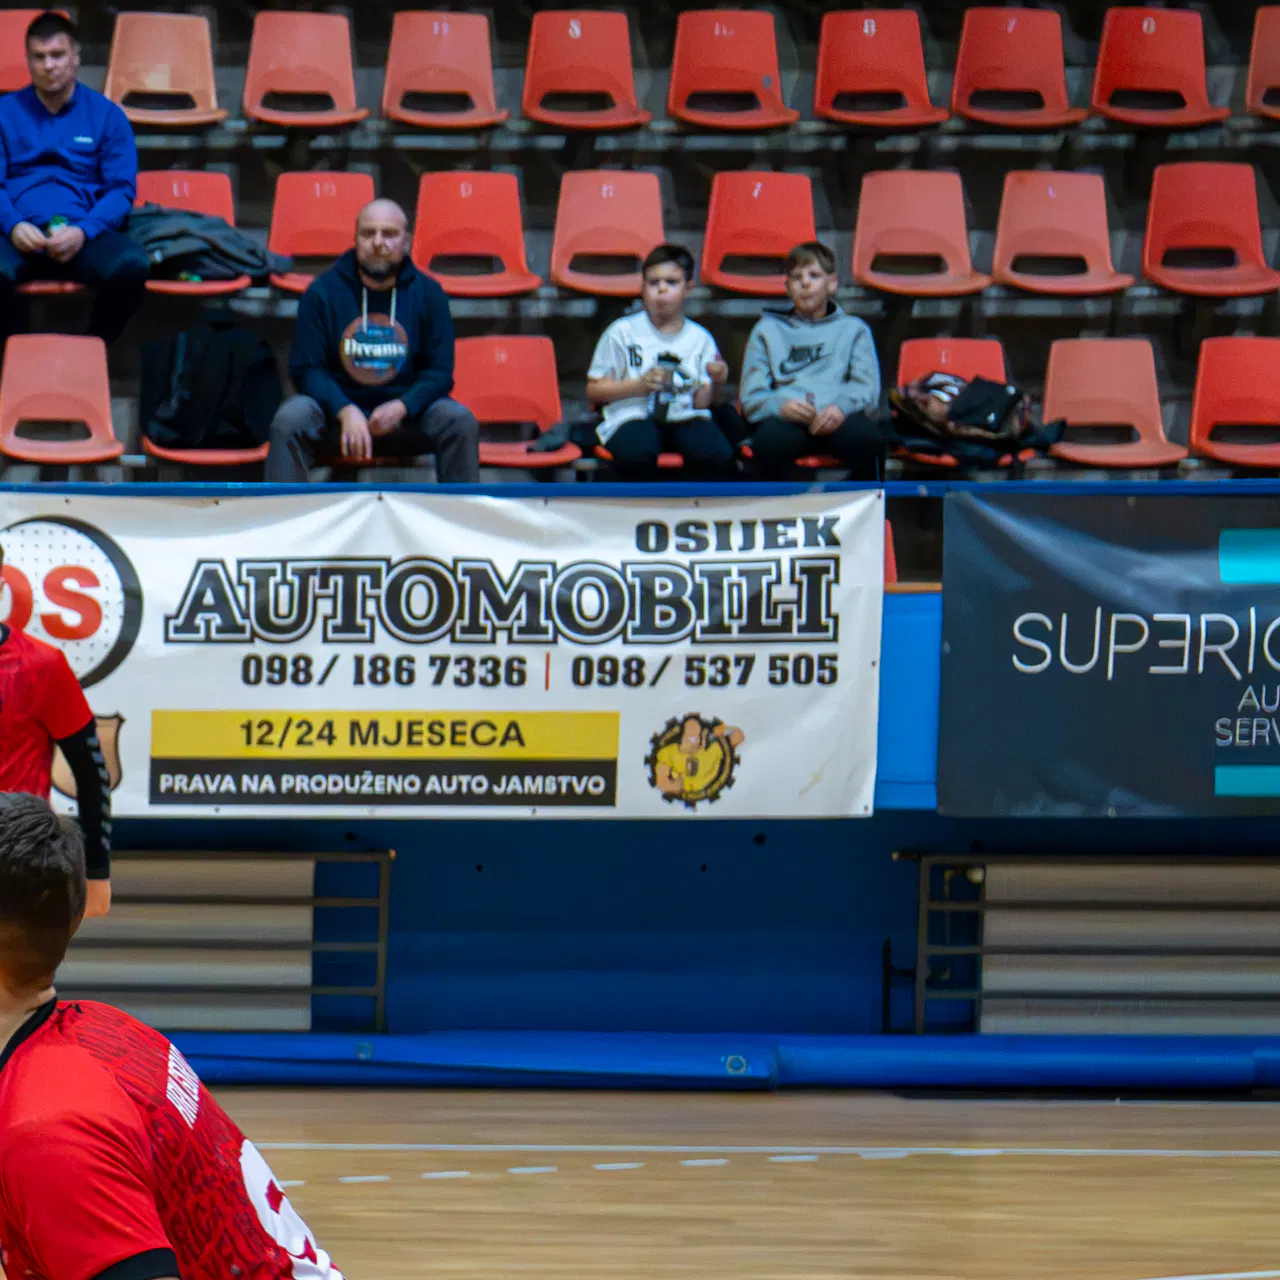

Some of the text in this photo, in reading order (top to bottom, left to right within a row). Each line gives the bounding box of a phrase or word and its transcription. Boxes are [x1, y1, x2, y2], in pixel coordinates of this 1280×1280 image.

[635, 516, 842, 553] OSIJEK
[164, 556, 840, 645] AUTOMOBILI
[241, 653, 839, 688] 098/ 186 7336 098/ 537 505
[239, 716, 526, 751] 12/24 MJESECA
[159, 769, 607, 796] PRAVA NA PRODUŽENO AUTO JAMSTVO
